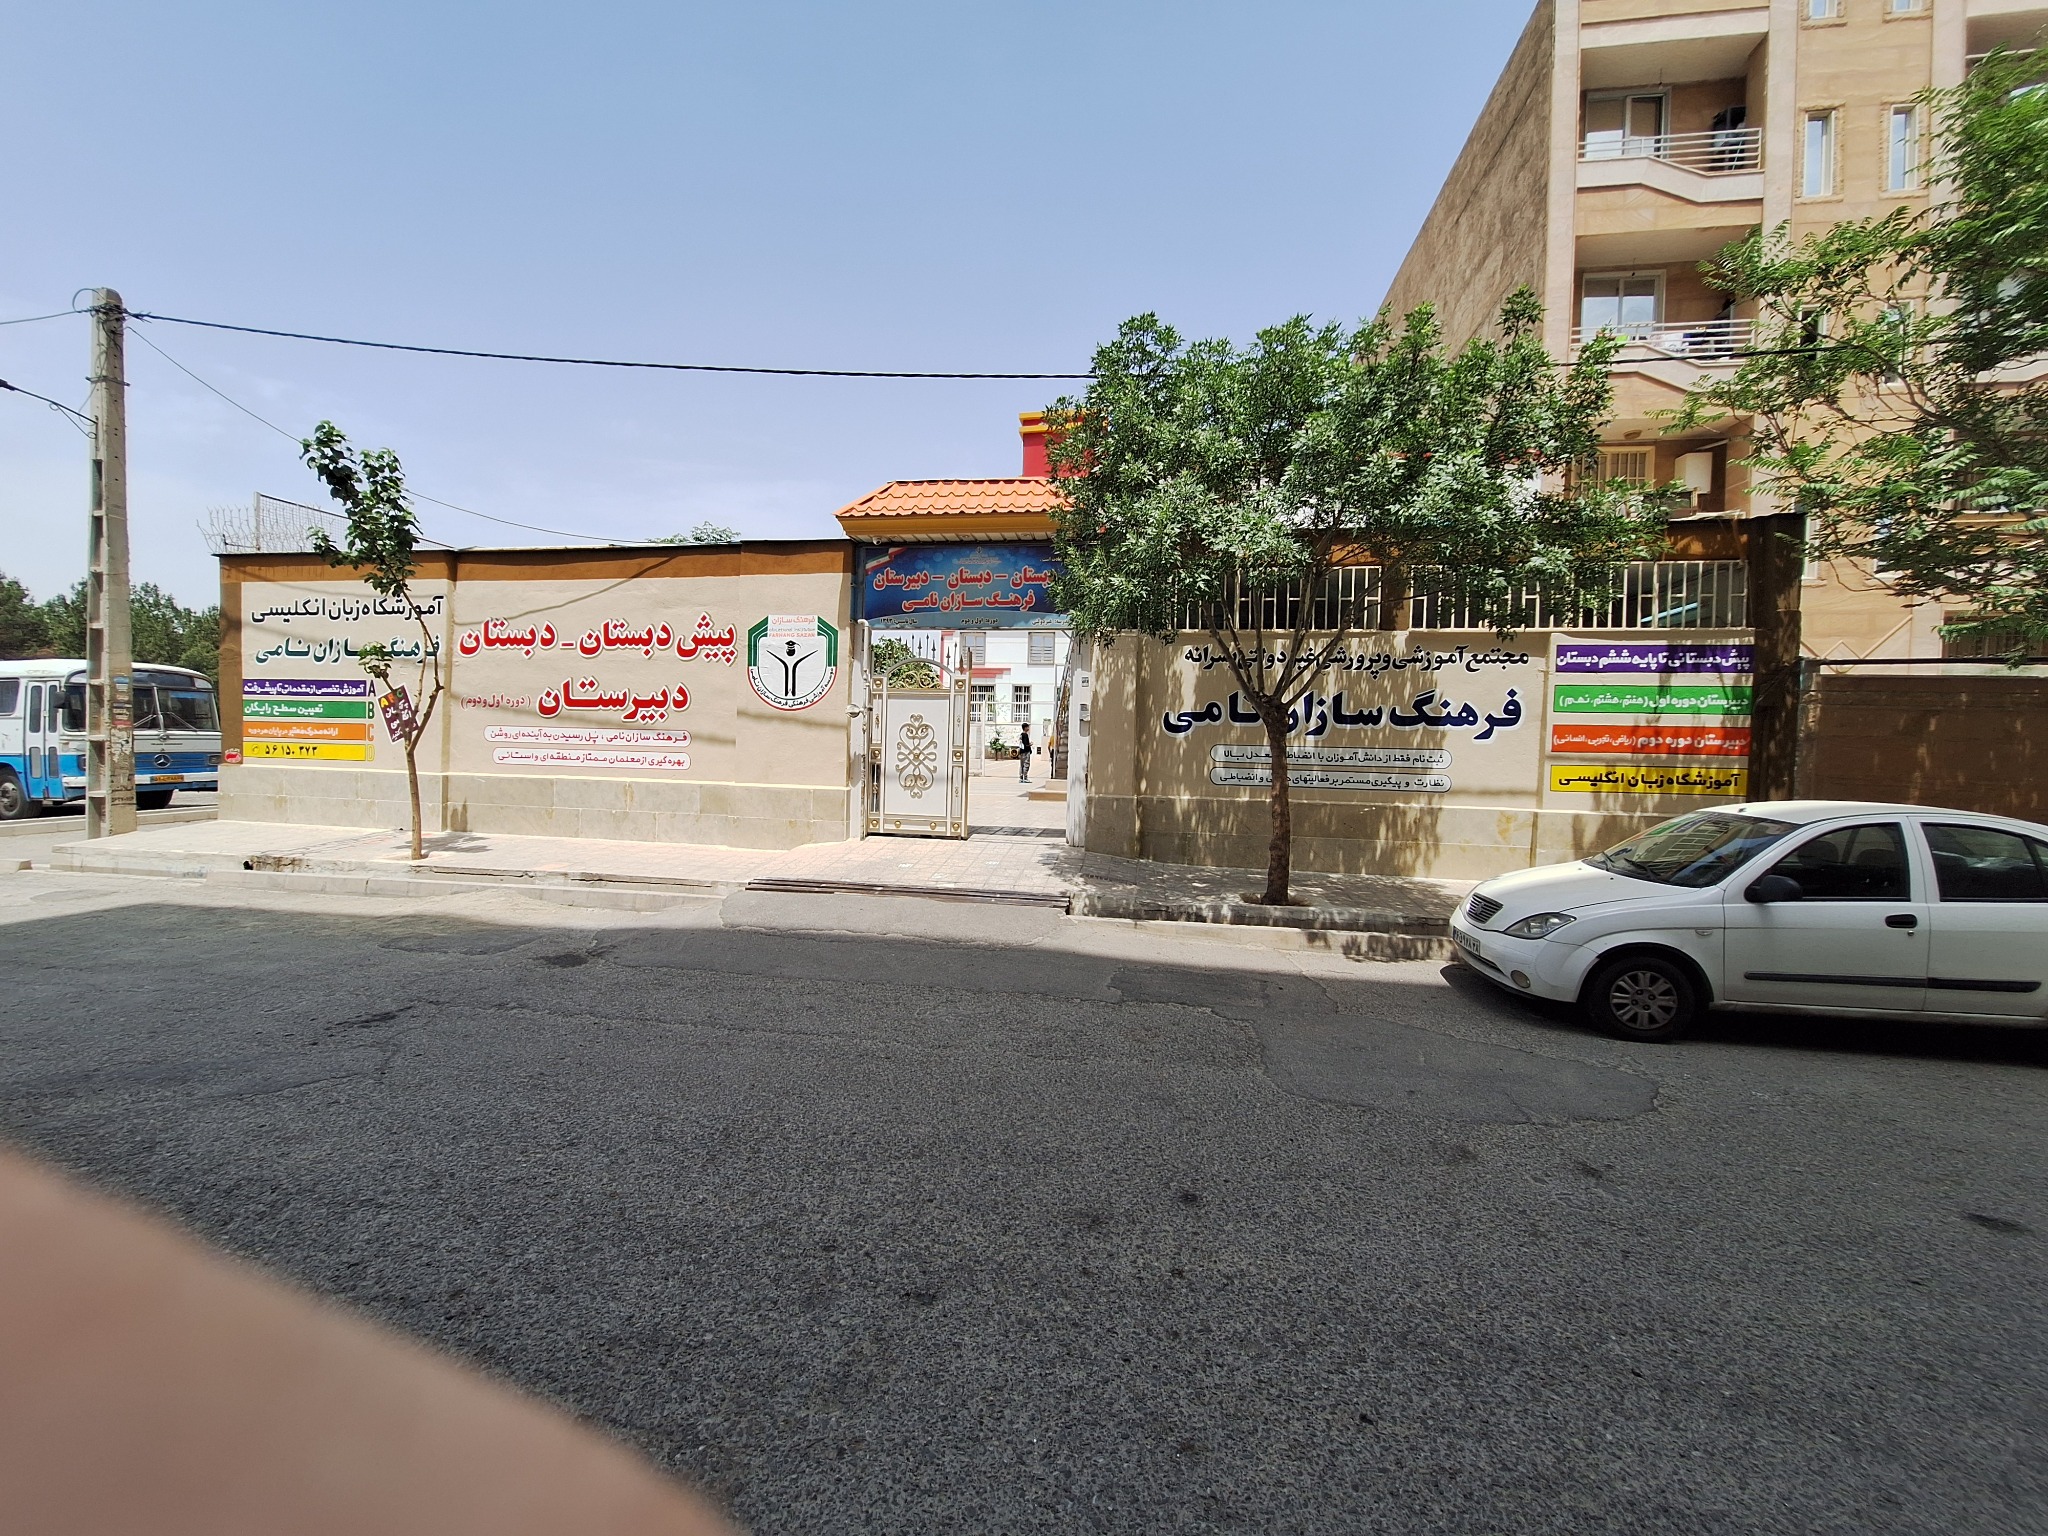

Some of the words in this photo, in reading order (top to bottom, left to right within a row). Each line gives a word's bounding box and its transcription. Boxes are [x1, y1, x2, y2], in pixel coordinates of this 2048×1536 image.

[873, 567, 929, 590] دبیرستان
[948, 567, 991, 589] دبستان
[902, 592, 938, 612] نامی
[940, 592, 984, 611] سازان
[986, 590, 1036, 611] فرهنگ
[251, 597, 326, 622] انگلیسی
[328, 598, 360, 621] زبان
[772, 616, 792, 625] سازان
[793, 616, 816, 624] فرهنگ
[459, 617, 556, 657] دبستان
[580, 618, 673, 657] دبستان
[678, 613, 736, 664] پیش
[255, 637, 311, 663] نامی
[1392, 644, 1469, 671] آموزشی
[1465, 647, 1529, 673] مجتمع
[1556, 651, 1599, 667] دبستان
[1599, 649, 1632, 668] ششم
[1632, 652, 1658, 670] پایه
[1658, 652, 1669, 664] تا
[1668, 652, 1722, 667] دبستانی
[1722, 649, 1750, 670] پیش
[243, 682, 277, 695] پیشرفته
[281, 684, 310, 693] مقدماتی
[315, 684, 340, 694] تخصصی
[340, 683, 365, 694] آموزش
[367, 680, 376, 697] A
[488, 693, 503, 708] اول
[538, 678, 690, 722] دبیرستان
[1648, 695, 1670, 708] اول
[1671, 697, 1697, 707] دوره
[1697, 694, 1749, 710] دبیرستان
[244, 702, 271, 714] رایگان
[273, 704, 297, 715] سطح
[298, 704, 323, 714] تعیین
[367, 702, 375, 719] B
[1390, 688, 1523, 739] فرهنگ
[367, 723, 375, 741] C
[490, 727, 511, 739] روشن
[522, 729, 542, 740] آینده
[543, 731, 552, 740] به
[552, 732, 583, 742] رسیدن
[625, 732, 650, 742] سازان
[652, 732, 688, 743] فرهنگ
[1638, 736, 1663, 748] دوم
[1665, 736, 1693, 748] دوره
[1694, 733, 1747, 749] دبیرستان
[265, 744, 278, 755] ۵۶
[367, 744, 375, 761] D
[498, 751, 534, 760] استانی
[1224, 750, 1245, 760] بالا
[549, 752, 580, 761] منطقه
[580, 753, 608, 763] ممتاز
[609, 755, 640, 764] معلمان
[640, 756, 647, 765] از
[1287, 750, 1315, 762] انضباط
[1317, 752, 1324, 762] با
[1326, 752, 1359, 763] آموزان
[1358, 752, 1382, 762] دانش
[1384, 754, 1391, 763] از
[1393, 753, 1411, 762] فقط
[1412, 754, 1425, 765] نام
[1426, 754, 1444, 765] ثبت
[1220, 773, 1258, 783] انضباطی
[1292, 774, 1330, 785] فعالیتهای
[1329, 778, 1339, 787] بر
[1340, 776, 1371, 786] مستمر
[1371, 776, 1402, 789] پیگیری
[1414, 777, 1445, 787] نظارت
[1559, 771, 1625, 786] انگلیسی
[1628, 774, 1664, 788] زبان
[1667, 771, 1741, 789] آموزشگاه
